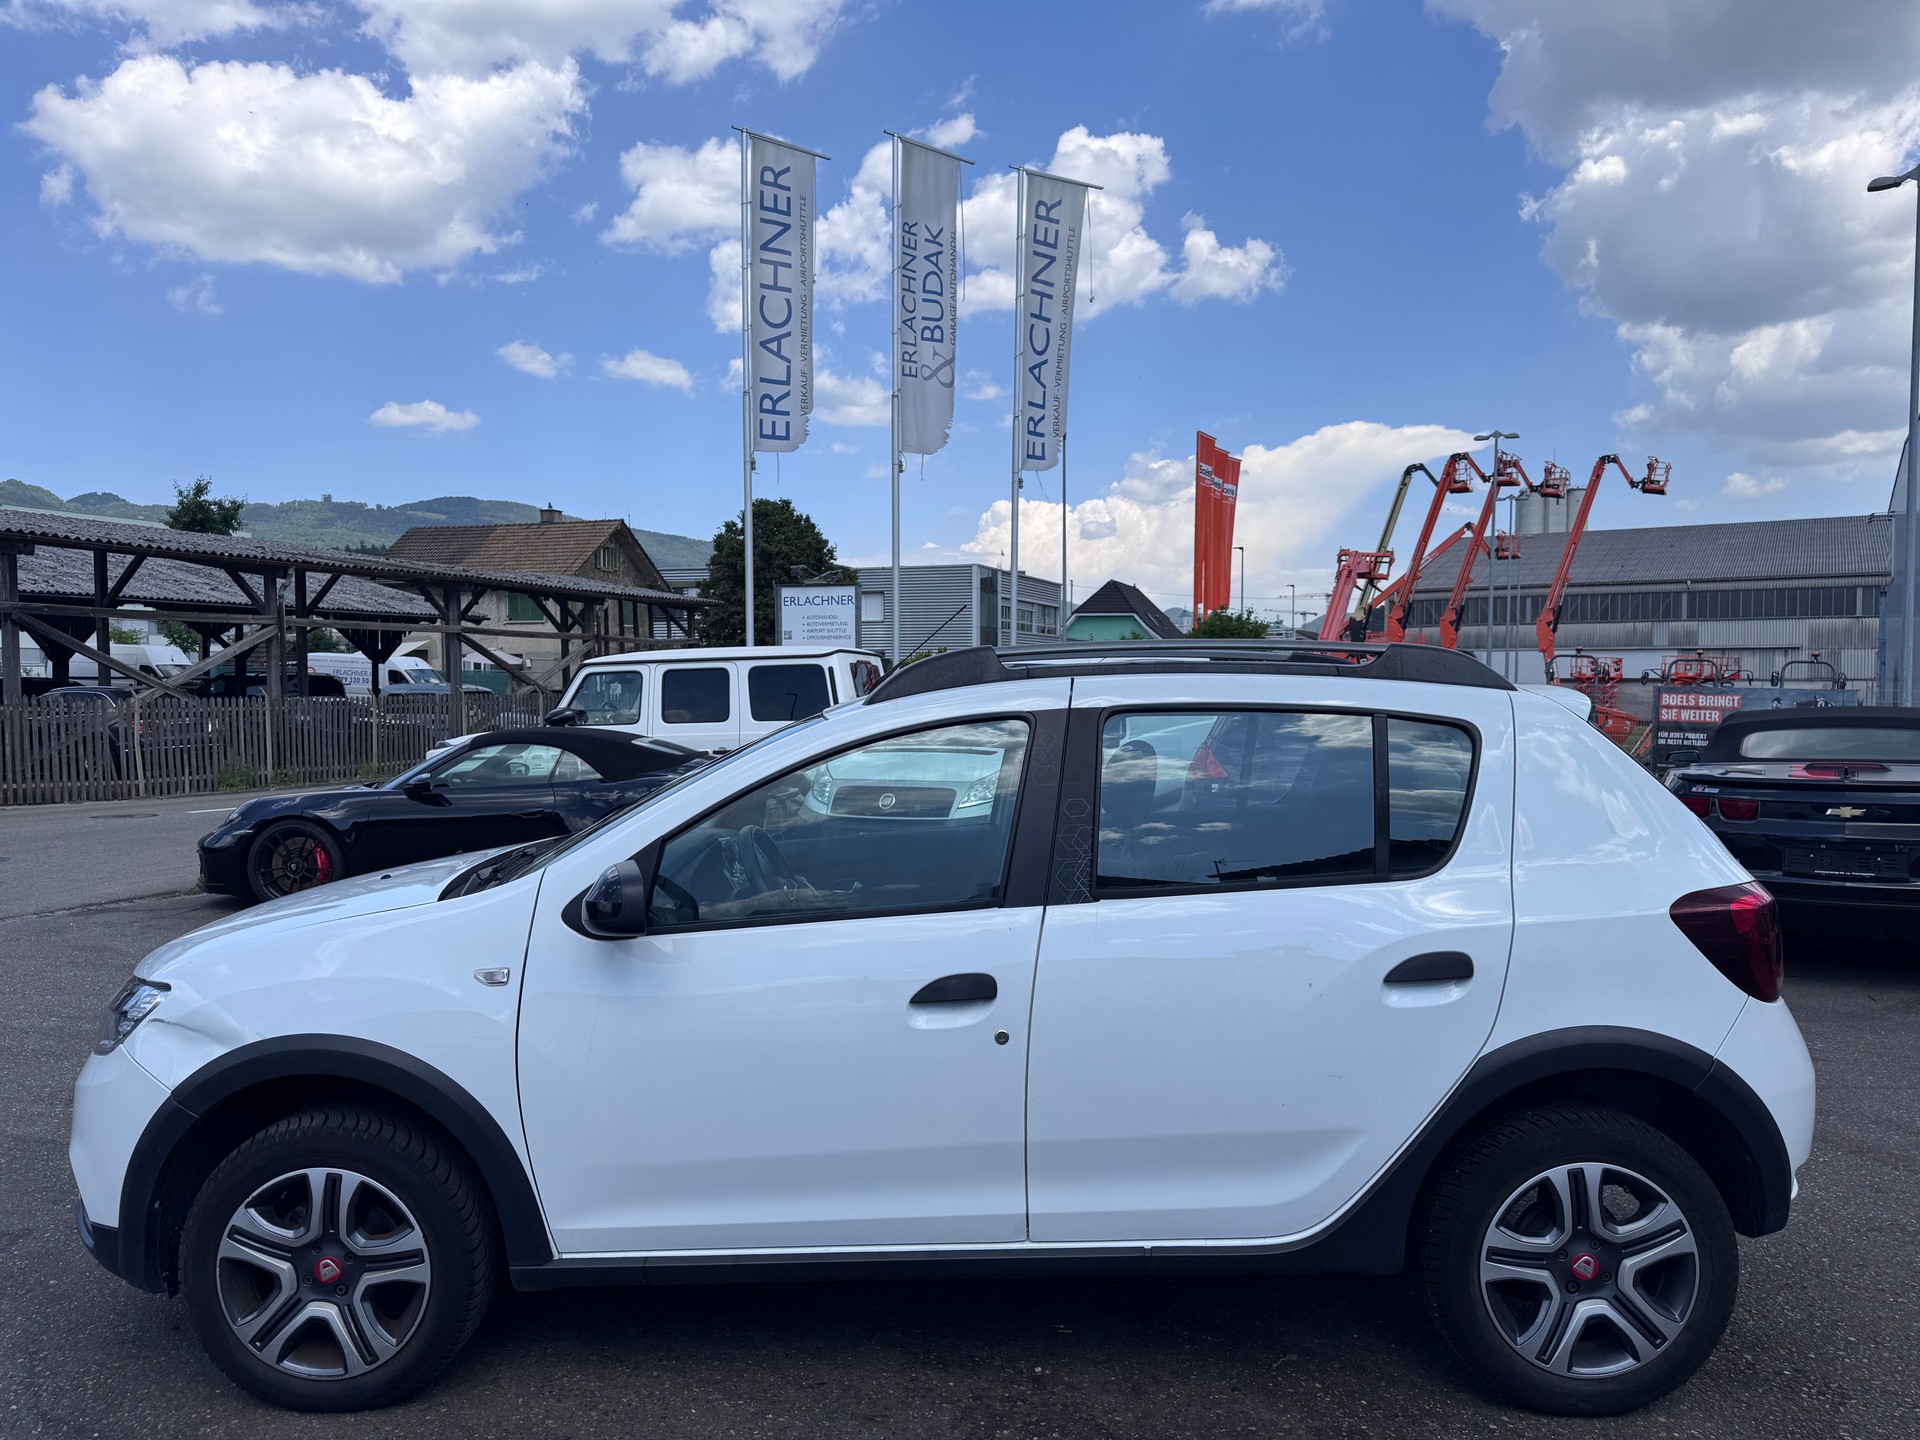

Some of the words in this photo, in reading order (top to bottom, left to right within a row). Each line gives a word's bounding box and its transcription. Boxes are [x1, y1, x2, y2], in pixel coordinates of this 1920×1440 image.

[799, 194, 807, 287] AIRPORTSHUTTLE
[1061, 225, 1076, 316] AIRPORTSHUTTLE
[759, 165, 792, 441] ERLACHNER
[901, 221, 918, 379] ERLACHNER
[920, 223, 944, 344] BUDAK
[800, 293, 808, 362] VERMIETUNG
[1026, 198, 1062, 460] ERLACHNER
[1054, 322, 1067, 388] VERMIETUNG
[800, 369, 808, 416] VERKAUF
[920, 345, 955, 389] &
[1052, 394, 1061, 438] VERKAUF
[783, 595, 855, 607] ERLACHNER
[1661, 709, 1678, 720] SIE
[1680, 709, 1720, 721] WEITER
[1662, 694, 1695, 706] BOELS
[1698, 695, 1740, 707] BRINGT
